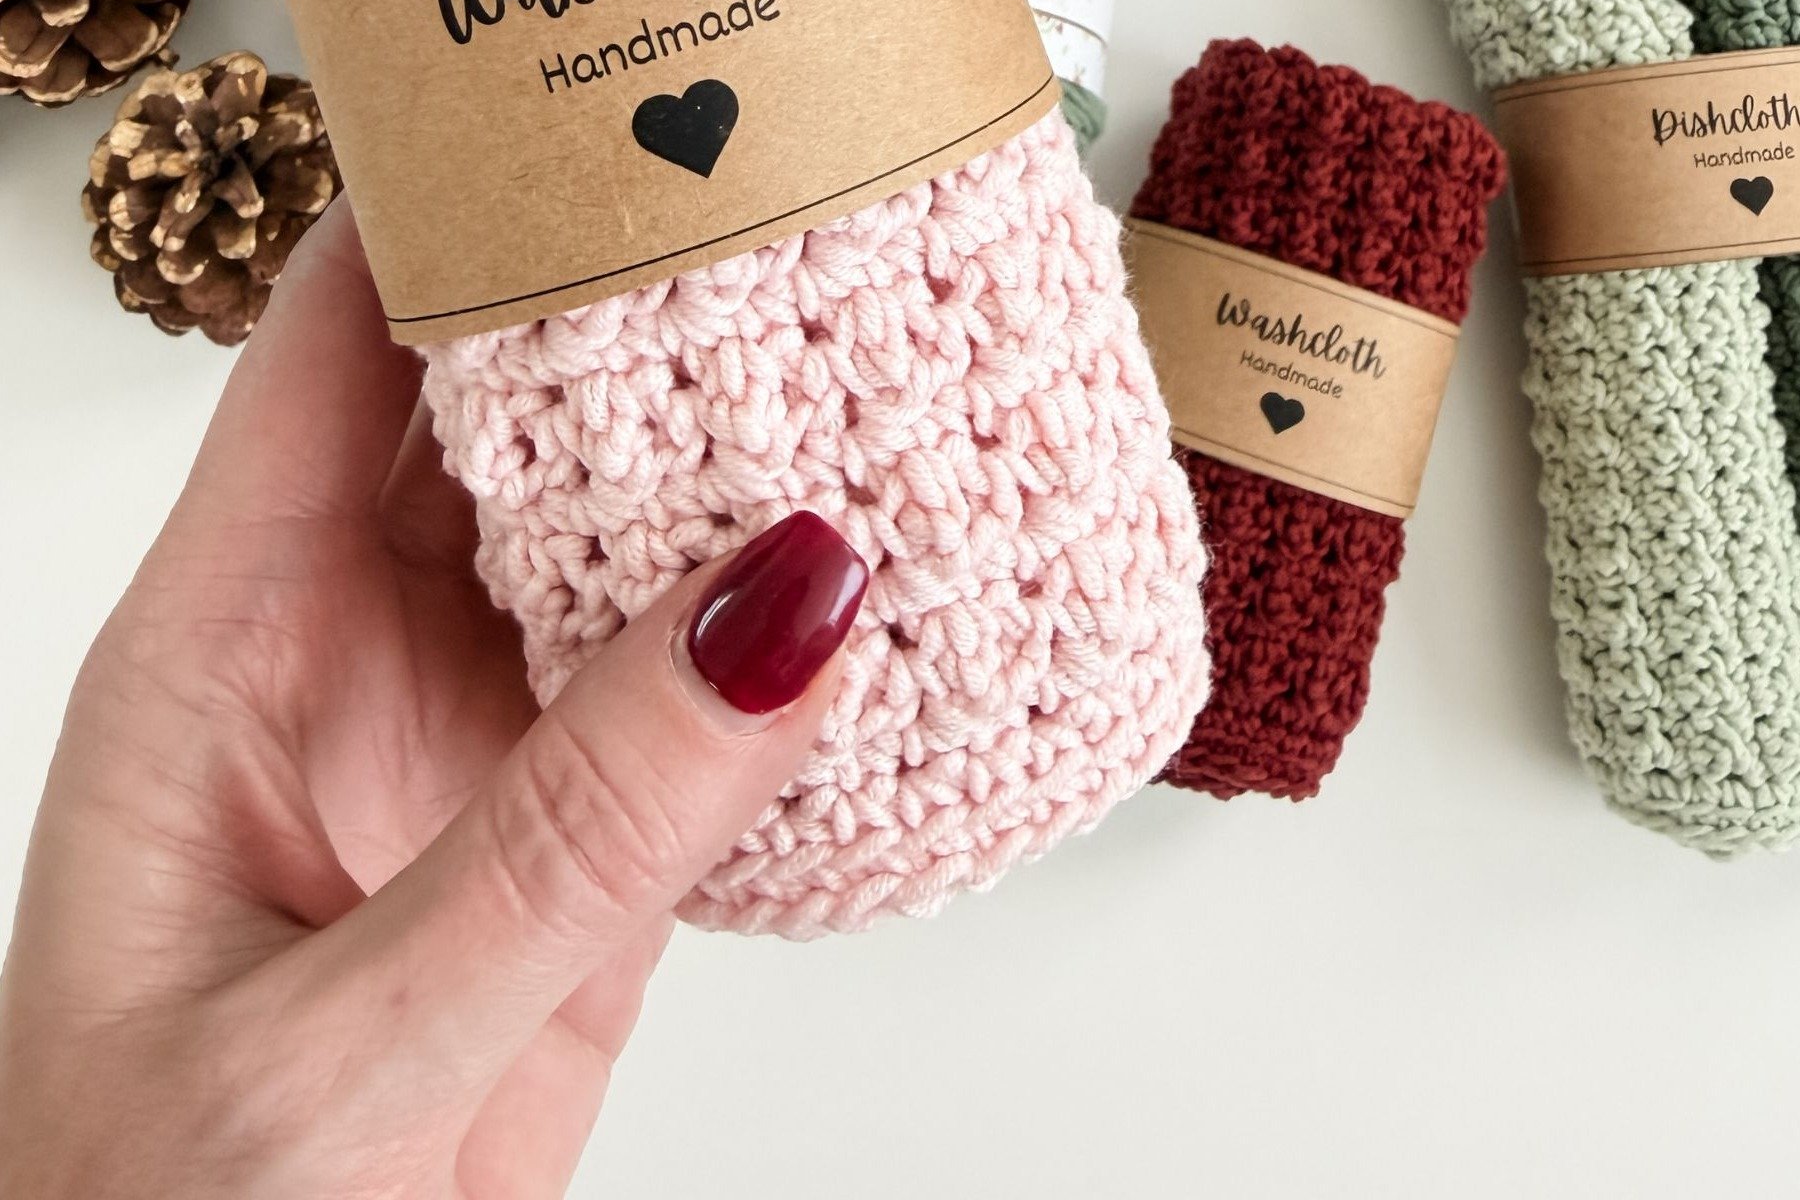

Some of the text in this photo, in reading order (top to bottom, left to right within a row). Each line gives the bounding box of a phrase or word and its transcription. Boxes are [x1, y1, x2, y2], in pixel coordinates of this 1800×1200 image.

[1651, 93, 1800, 147] Dishcloth
[1693, 141, 1796, 169] Handmade
[1216, 292, 1387, 380] Washcloth
[1239, 349, 1344, 399] Handmade
